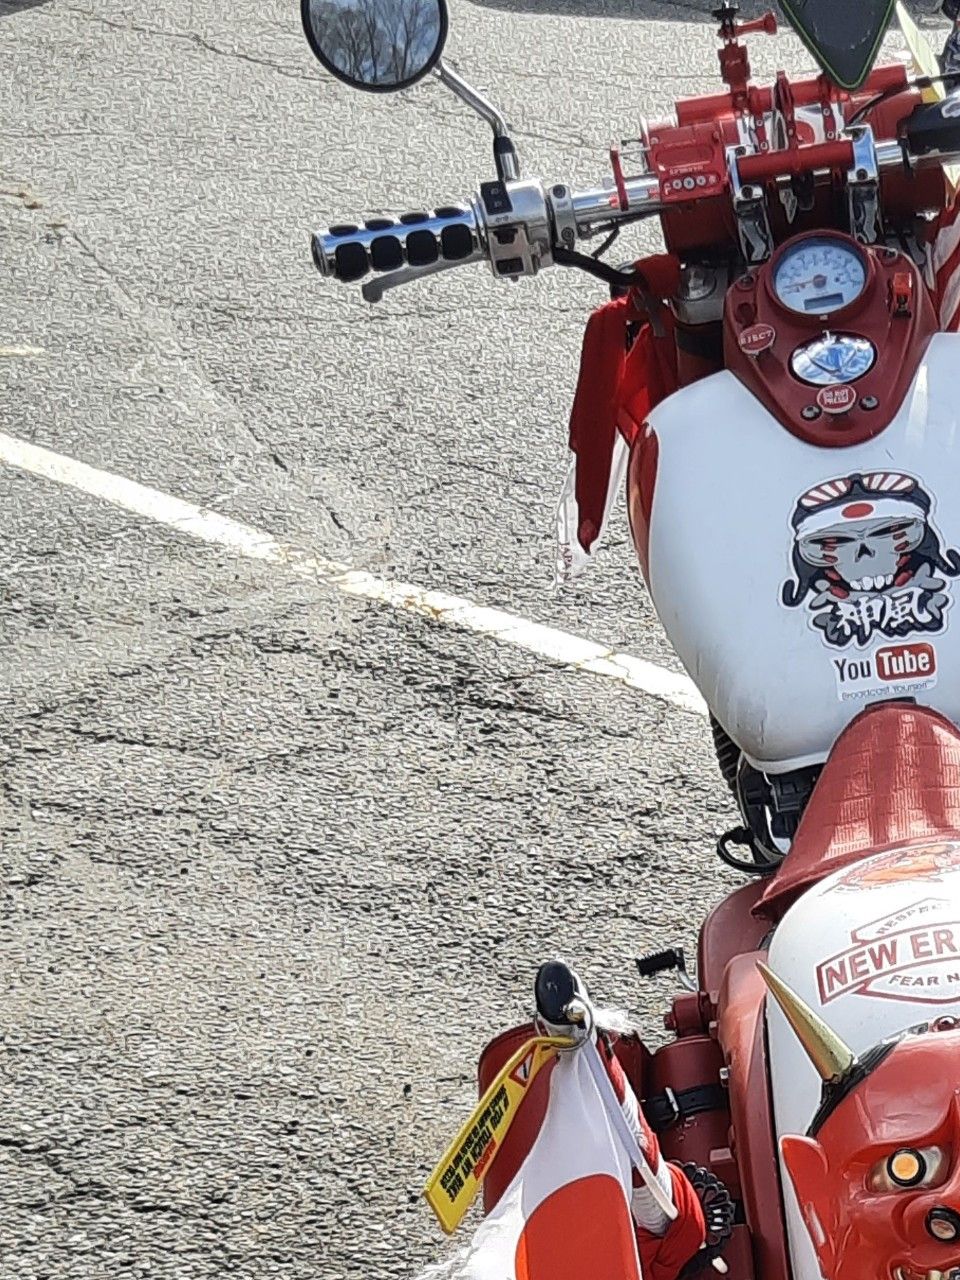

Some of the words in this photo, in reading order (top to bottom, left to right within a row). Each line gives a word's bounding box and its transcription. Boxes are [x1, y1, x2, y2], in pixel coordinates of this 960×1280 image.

[876, 903, 951, 934] RESPEC
[825, 939, 897, 993] NEW
[888, 973, 940, 987] FEAR
